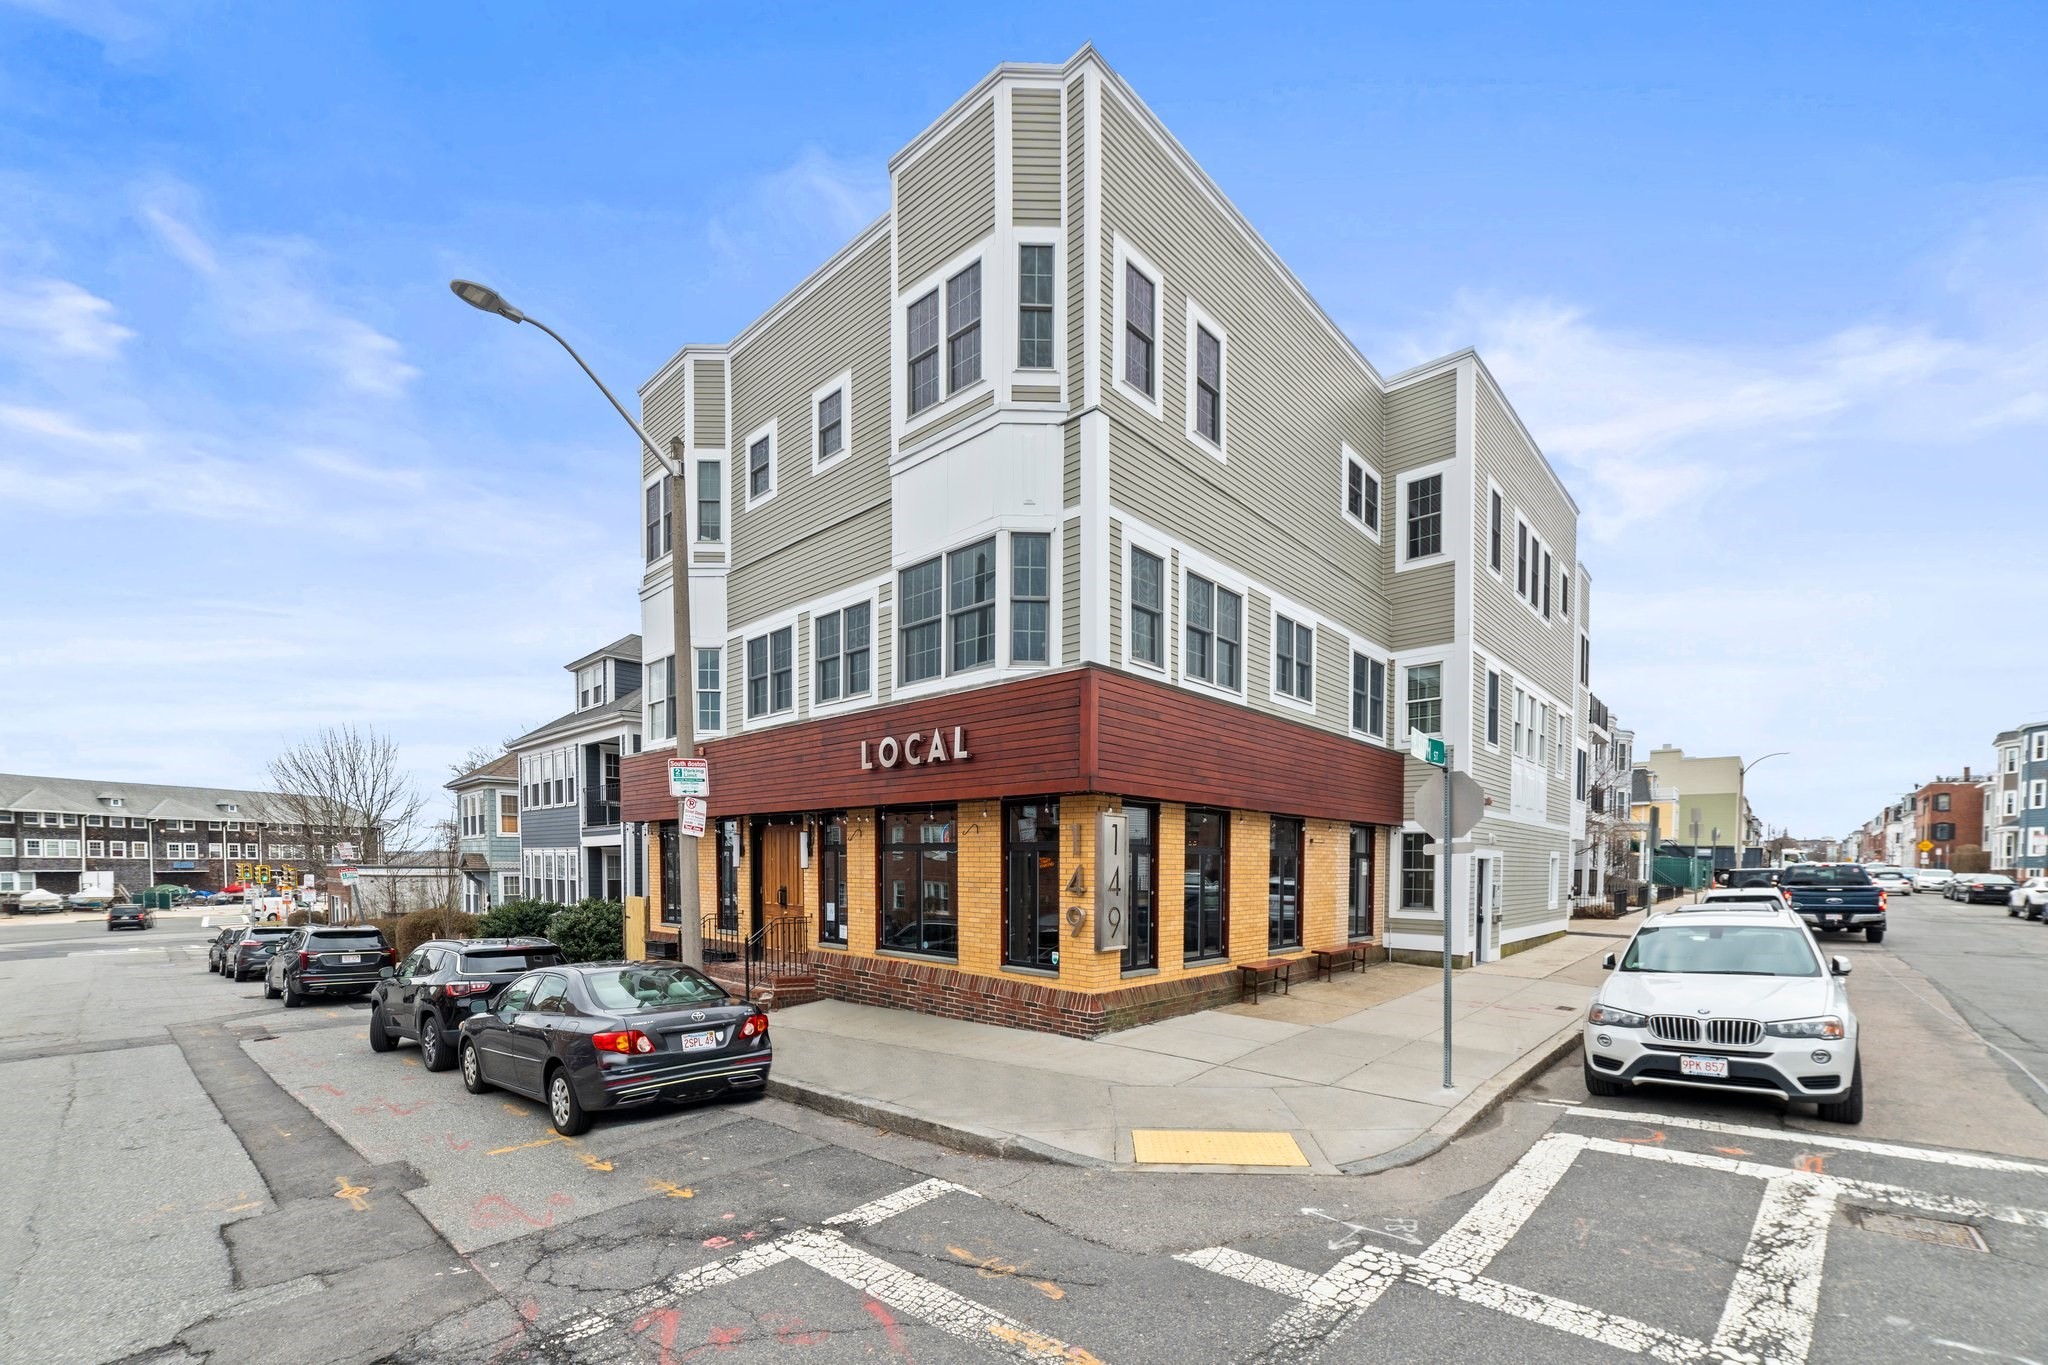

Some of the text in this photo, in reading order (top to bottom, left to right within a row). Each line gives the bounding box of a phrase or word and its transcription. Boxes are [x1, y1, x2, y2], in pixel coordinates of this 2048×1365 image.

[861, 726, 969, 770] LOCAL
[1065, 823, 1087, 938] 149
[1108, 823, 1121, 939] 149
[684, 1035, 714, 1049] 2SPL 49
[1682, 1059, 1725, 1073] 9PK 857
